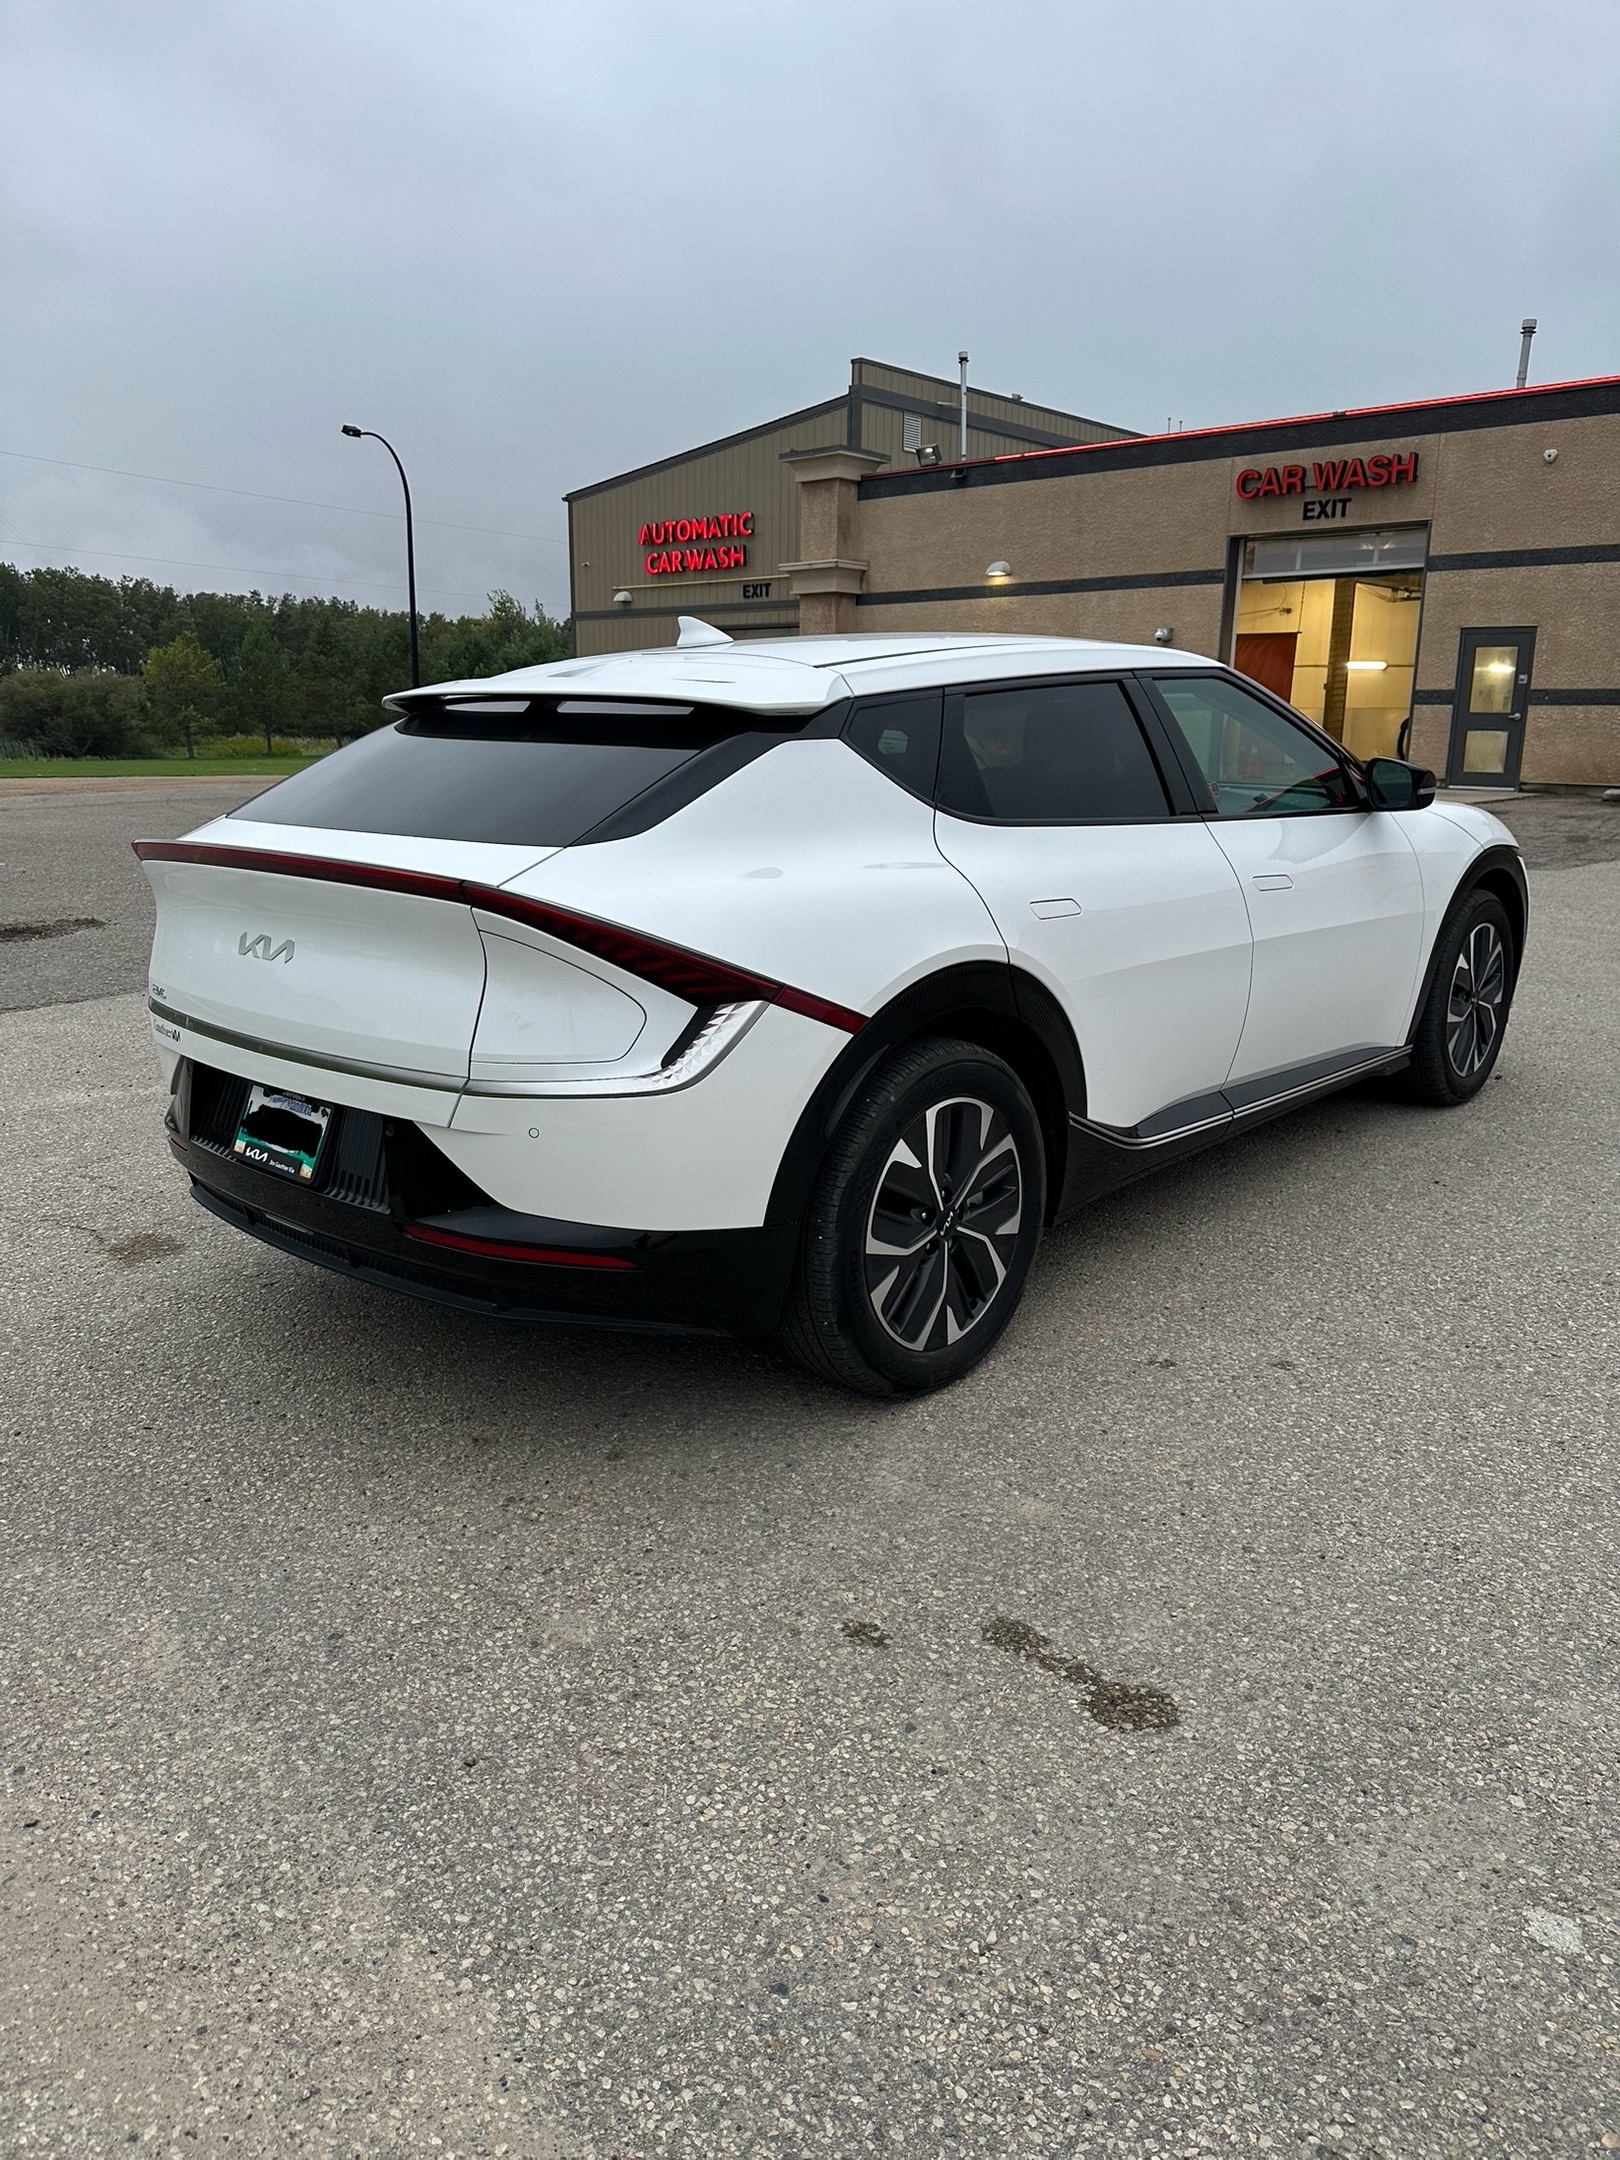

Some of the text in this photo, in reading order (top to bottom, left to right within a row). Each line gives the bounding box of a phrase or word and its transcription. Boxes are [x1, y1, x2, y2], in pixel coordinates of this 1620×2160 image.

[1236, 452, 1418, 500] CAR WASH
[1303, 498, 1351, 520] EXIT
[638, 511, 754, 546] AUTOMATIC
[645, 545, 746, 575] CAR WASH
[742, 582, 771, 599] EXIT
[238, 932, 295, 963] KIA
[245, 1146, 268, 1162] KIA
